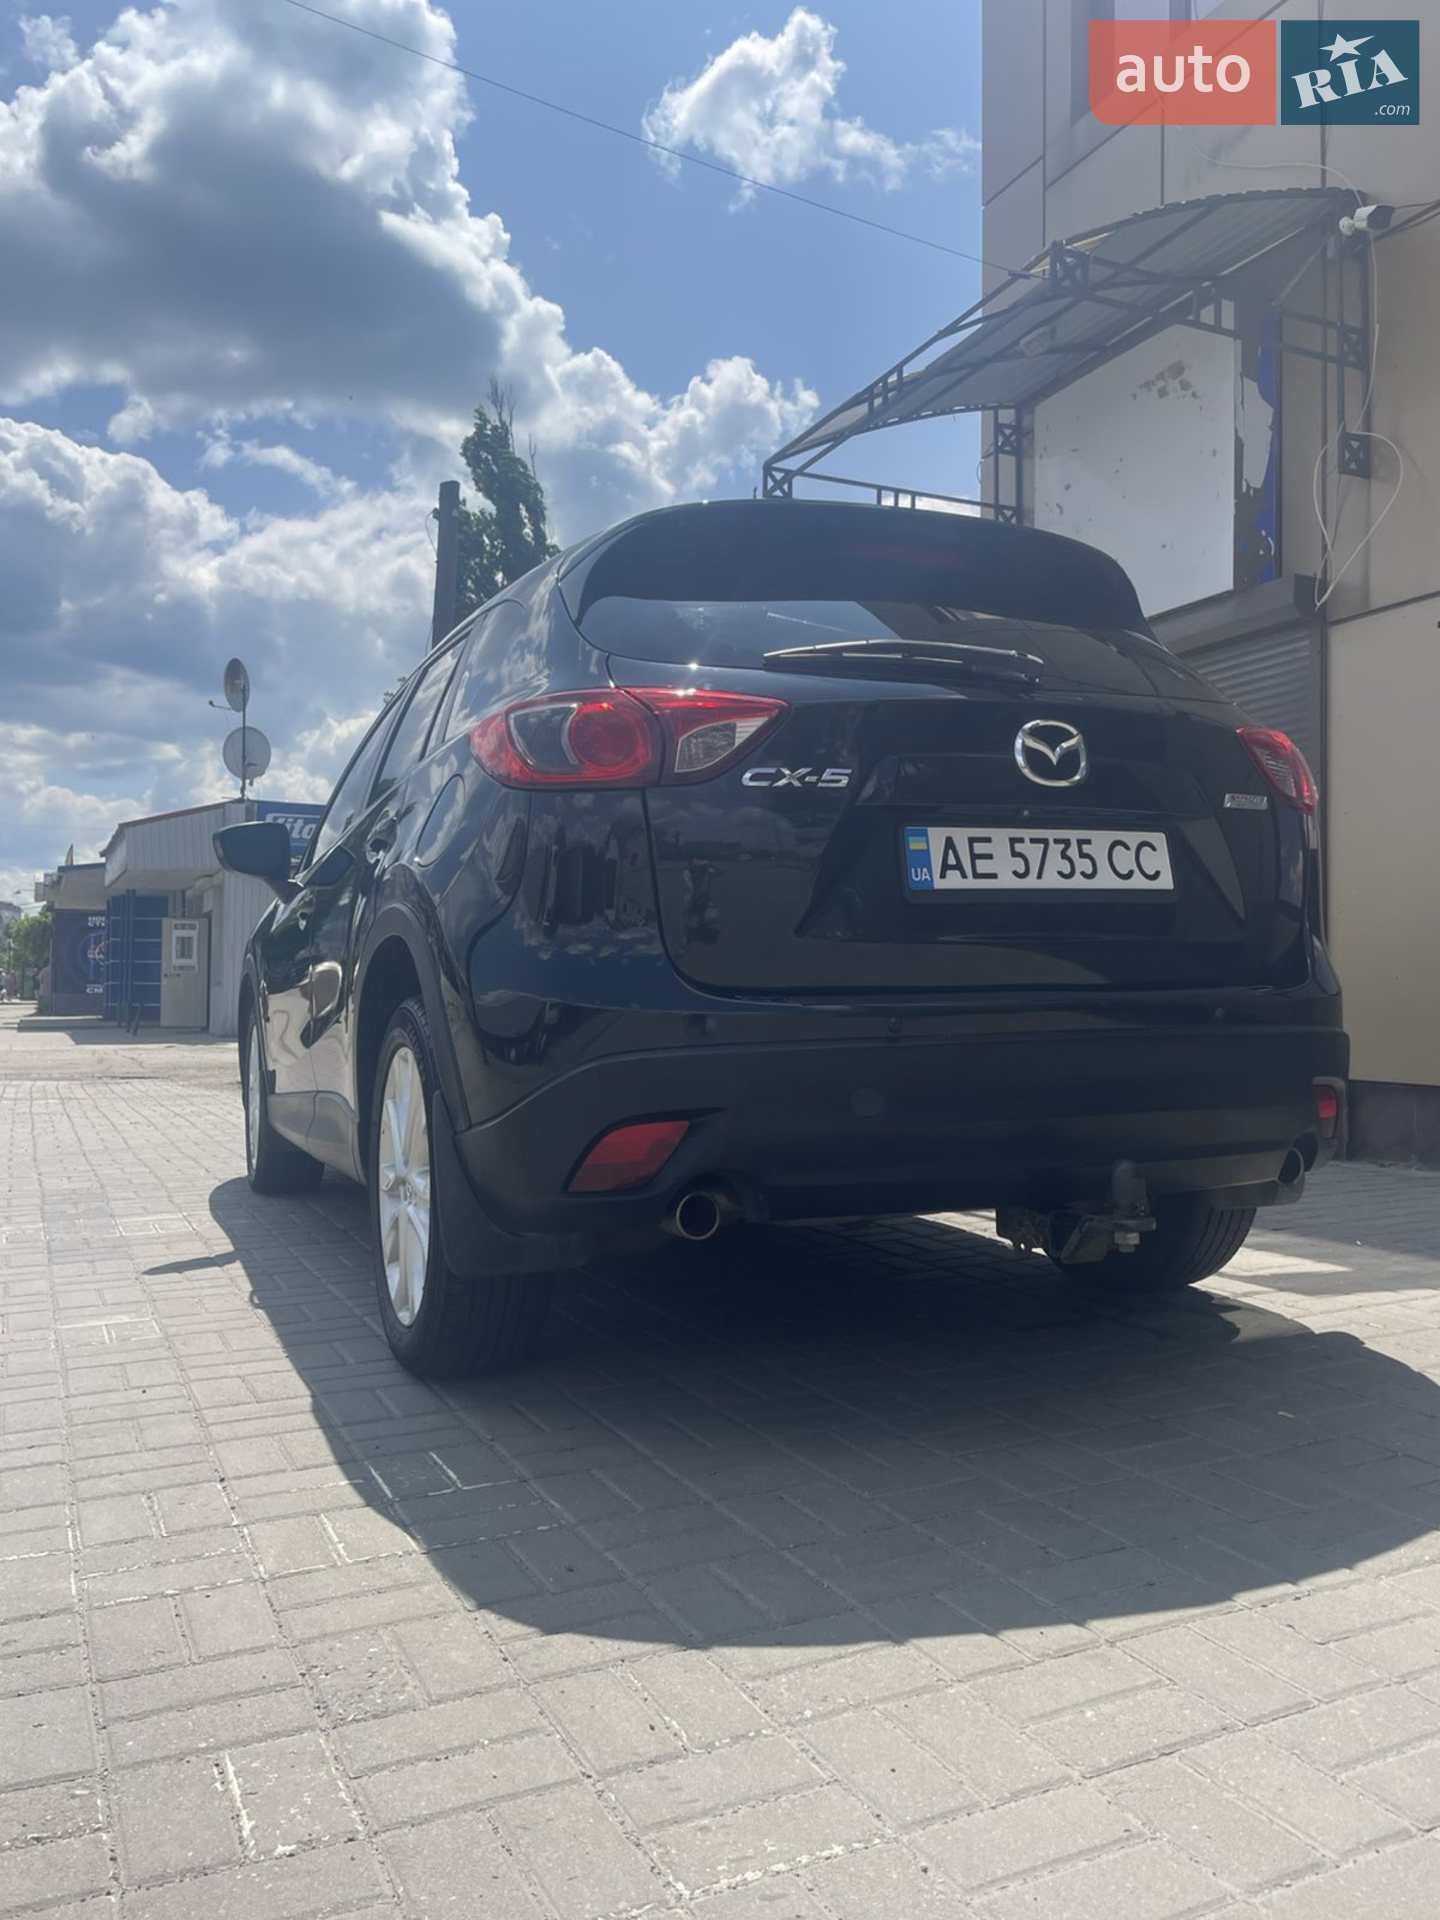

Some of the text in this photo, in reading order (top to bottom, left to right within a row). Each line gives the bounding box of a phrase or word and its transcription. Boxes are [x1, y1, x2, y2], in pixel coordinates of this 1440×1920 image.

[741, 767, 853, 788] CX-5
[939, 836, 1161, 881] AE 5735 CC
[911, 867, 931, 882] UA
